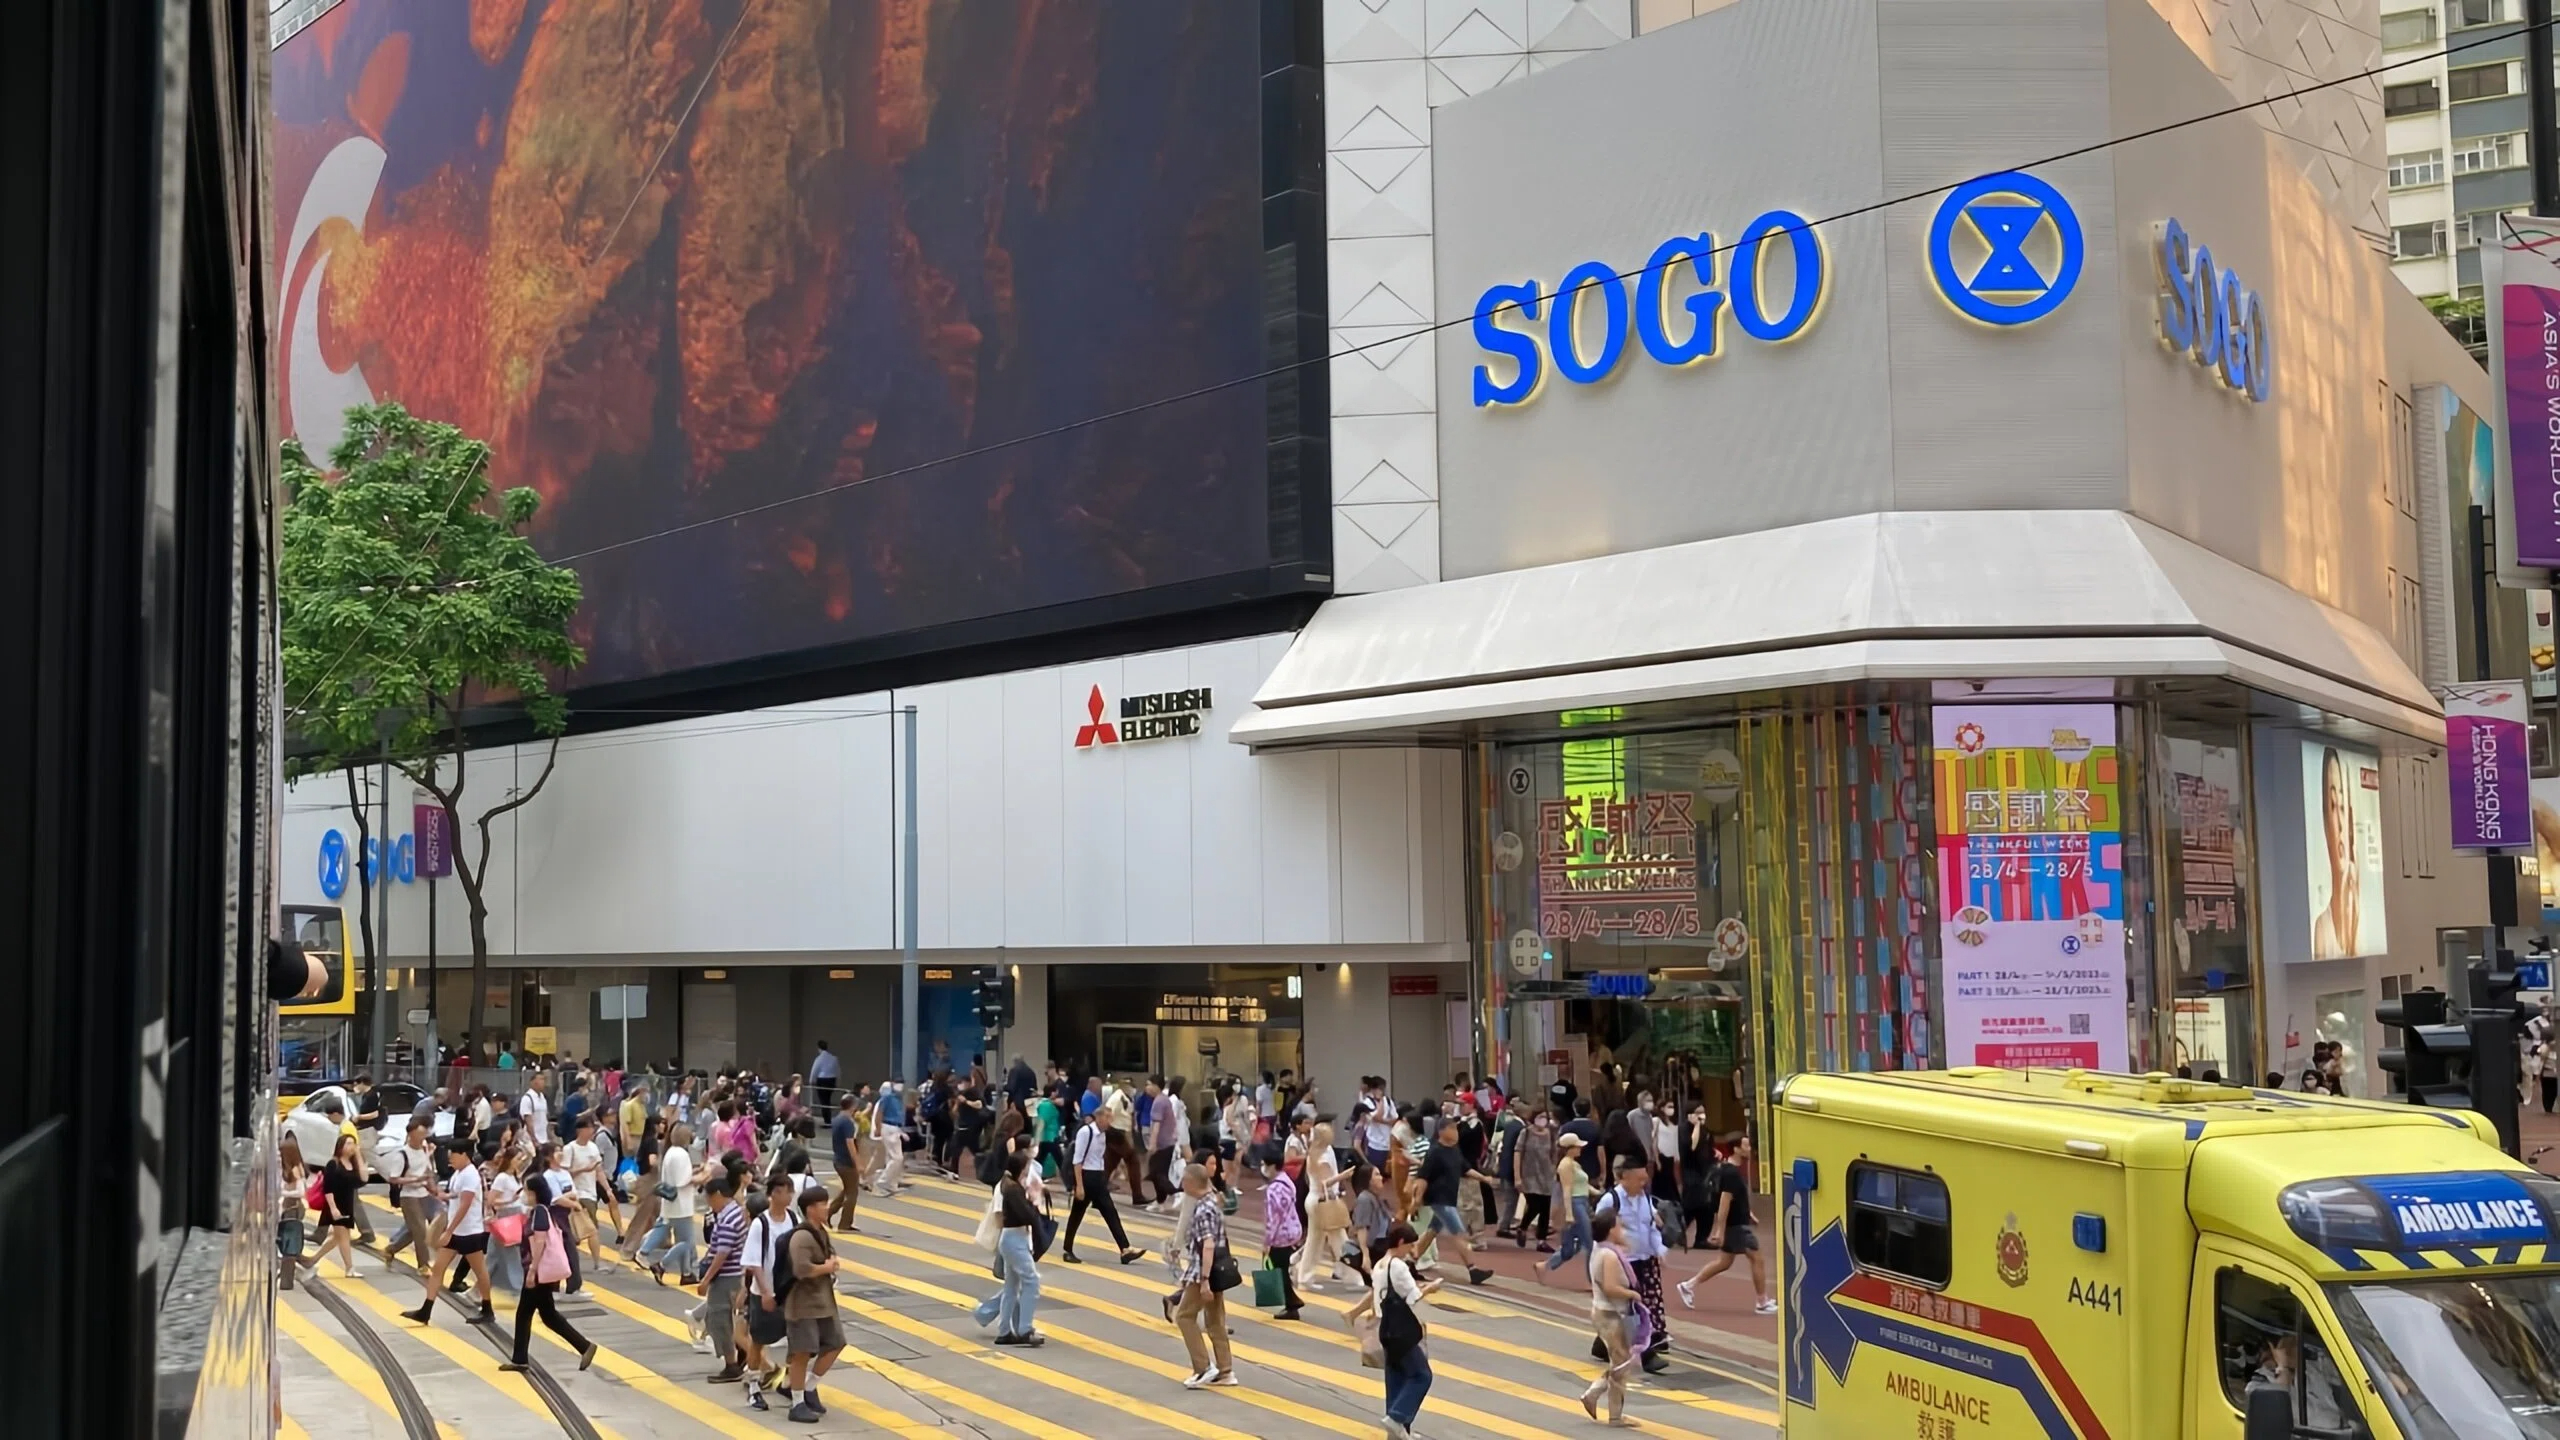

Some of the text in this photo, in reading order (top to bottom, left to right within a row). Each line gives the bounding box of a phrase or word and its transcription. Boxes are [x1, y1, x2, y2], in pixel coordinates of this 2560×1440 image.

[1472, 208, 1824, 409] SOGO
[2160, 216, 2272, 402] SOGO
[2542, 309, 2560, 390] ASIA'S
[1120, 686, 1213, 718] MITSUBISHI
[1120, 712, 1201, 742] ELECTRIC
[2480, 724, 2502, 839] HONG KONG
[1538, 791, 1696, 863] 感謝祭
[1965, 789, 2091, 832] 感謝祭
[2475, 810, 2486, 839] CITY
[1967, 837, 2091, 850] THANKFUL WEEKS
[1542, 873, 1696, 893] THANKFUL WEEKS
[2397, 1199, 2543, 1234] AMBULANCE
[2067, 1276, 2123, 1316] A441
[1885, 1371, 1991, 1426] AMBULANCE
